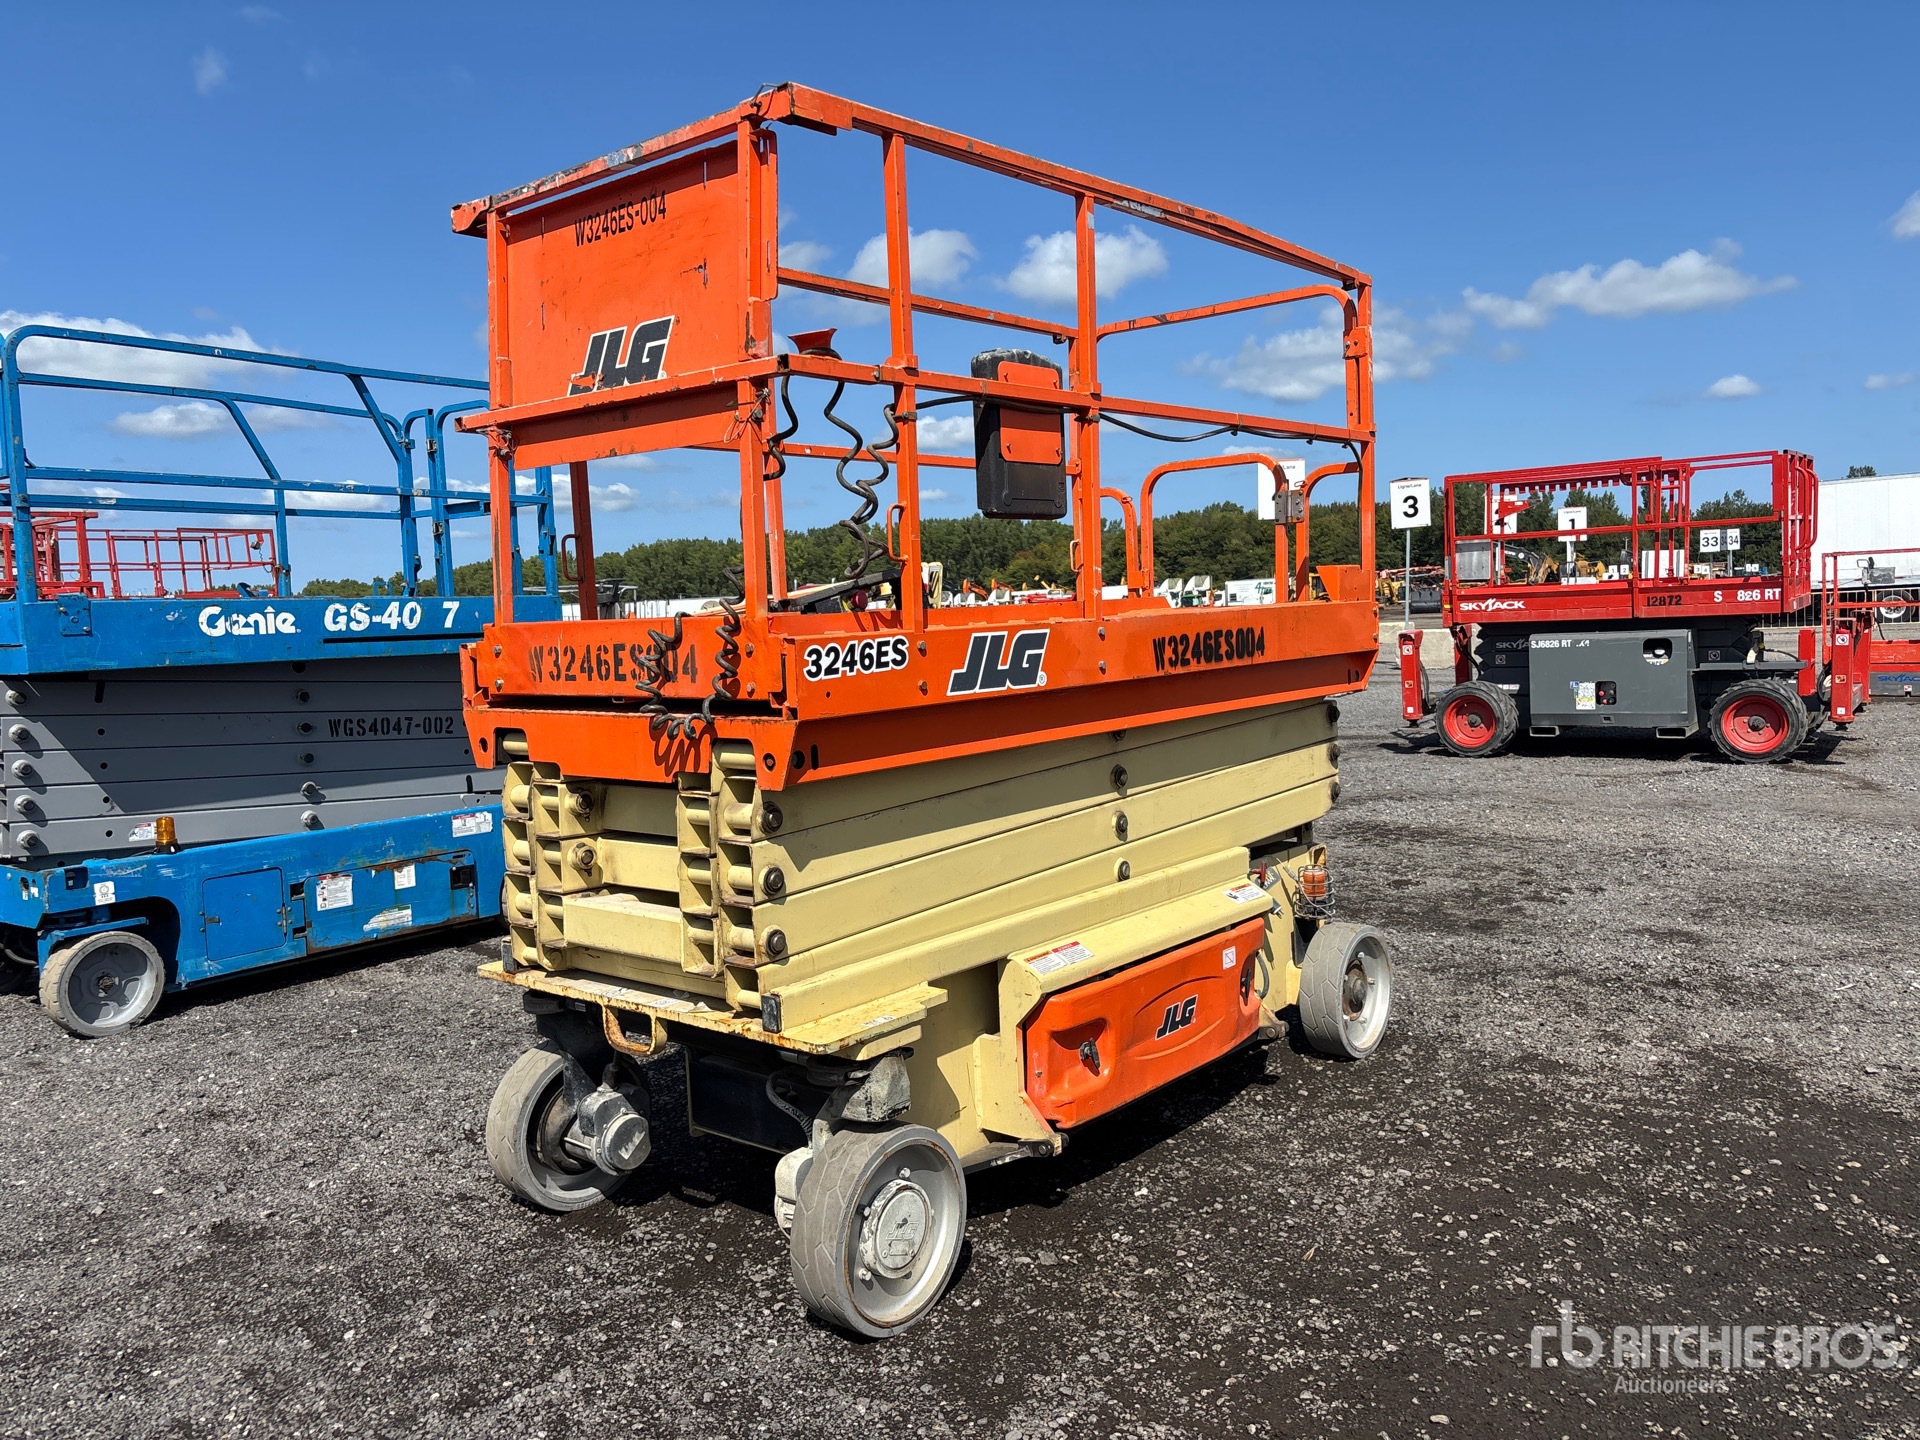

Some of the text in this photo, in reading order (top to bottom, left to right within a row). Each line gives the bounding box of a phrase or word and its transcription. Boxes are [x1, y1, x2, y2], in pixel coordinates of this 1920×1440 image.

[575, 190, 667, 247] W3246ES-004
[567, 315, 675, 397] JLG
[1402, 495, 1419, 518] 3
[1702, 536, 1719, 548] 33
[1728, 535, 1739, 546] 34
[1460, 598, 1526, 611] SKYJACK
[1647, 594, 1682, 607] 12872
[1764, 588, 1782, 600] RT
[198, 606, 298, 637] Genie
[1152, 626, 1266, 672] W3246ES004
[1531, 640, 1560, 649] SJ6826
[1561, 639, 1572, 648] RT
[804, 636, 909, 680] 3246ES
[946, 629, 1050, 696] JLG
[328, 716, 454, 738] WGS4047-002
[1155, 994, 1199, 1041] JLG
[886, 1221, 919, 1240] JLG
